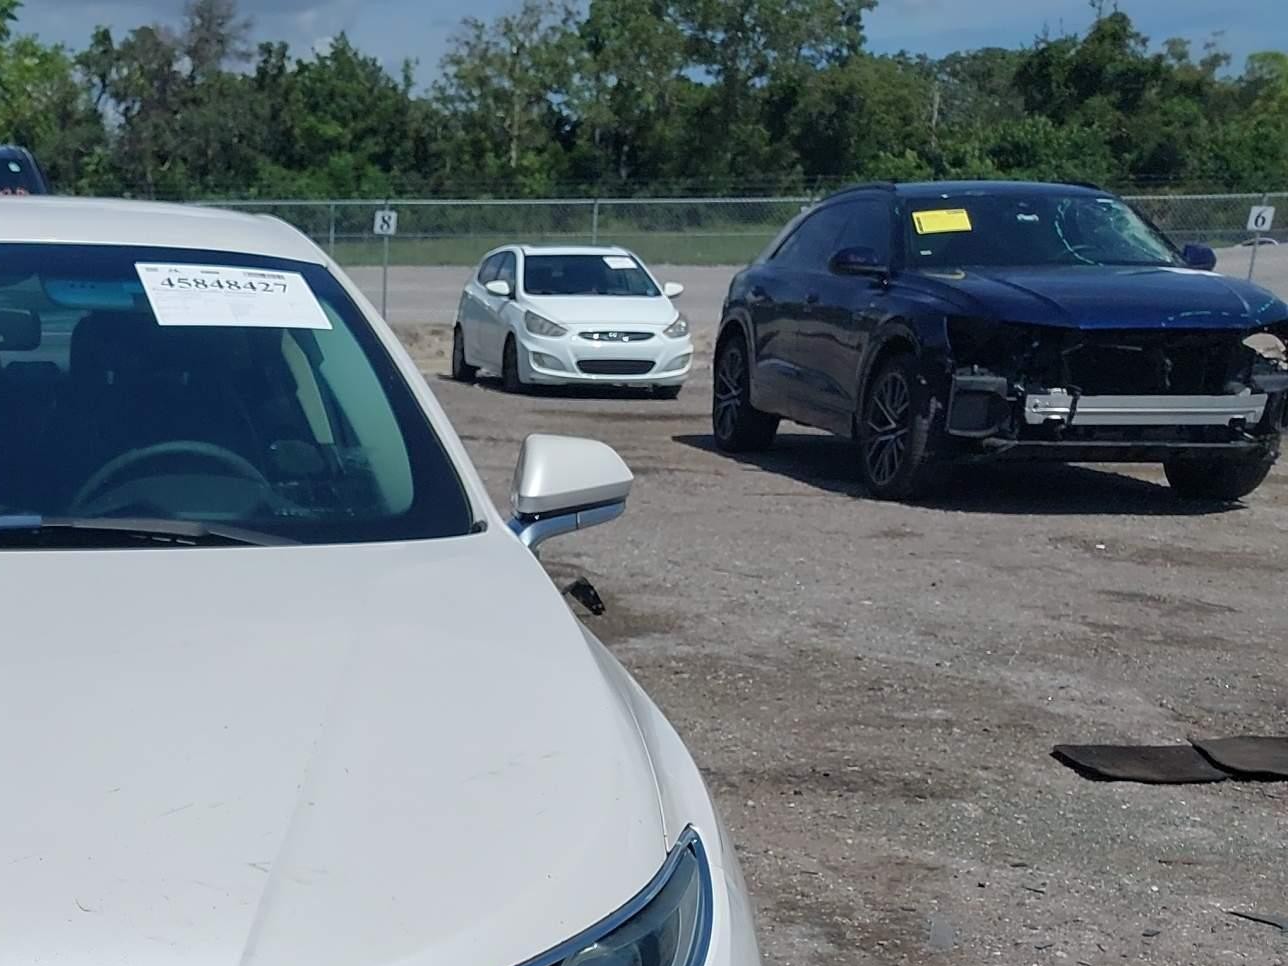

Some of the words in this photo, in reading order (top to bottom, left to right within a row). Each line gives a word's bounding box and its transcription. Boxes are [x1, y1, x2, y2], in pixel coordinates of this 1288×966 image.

[380, 214, 392, 232] 8
[1254, 209, 1267, 228] 6
[160, 276, 288, 294] 45848427
